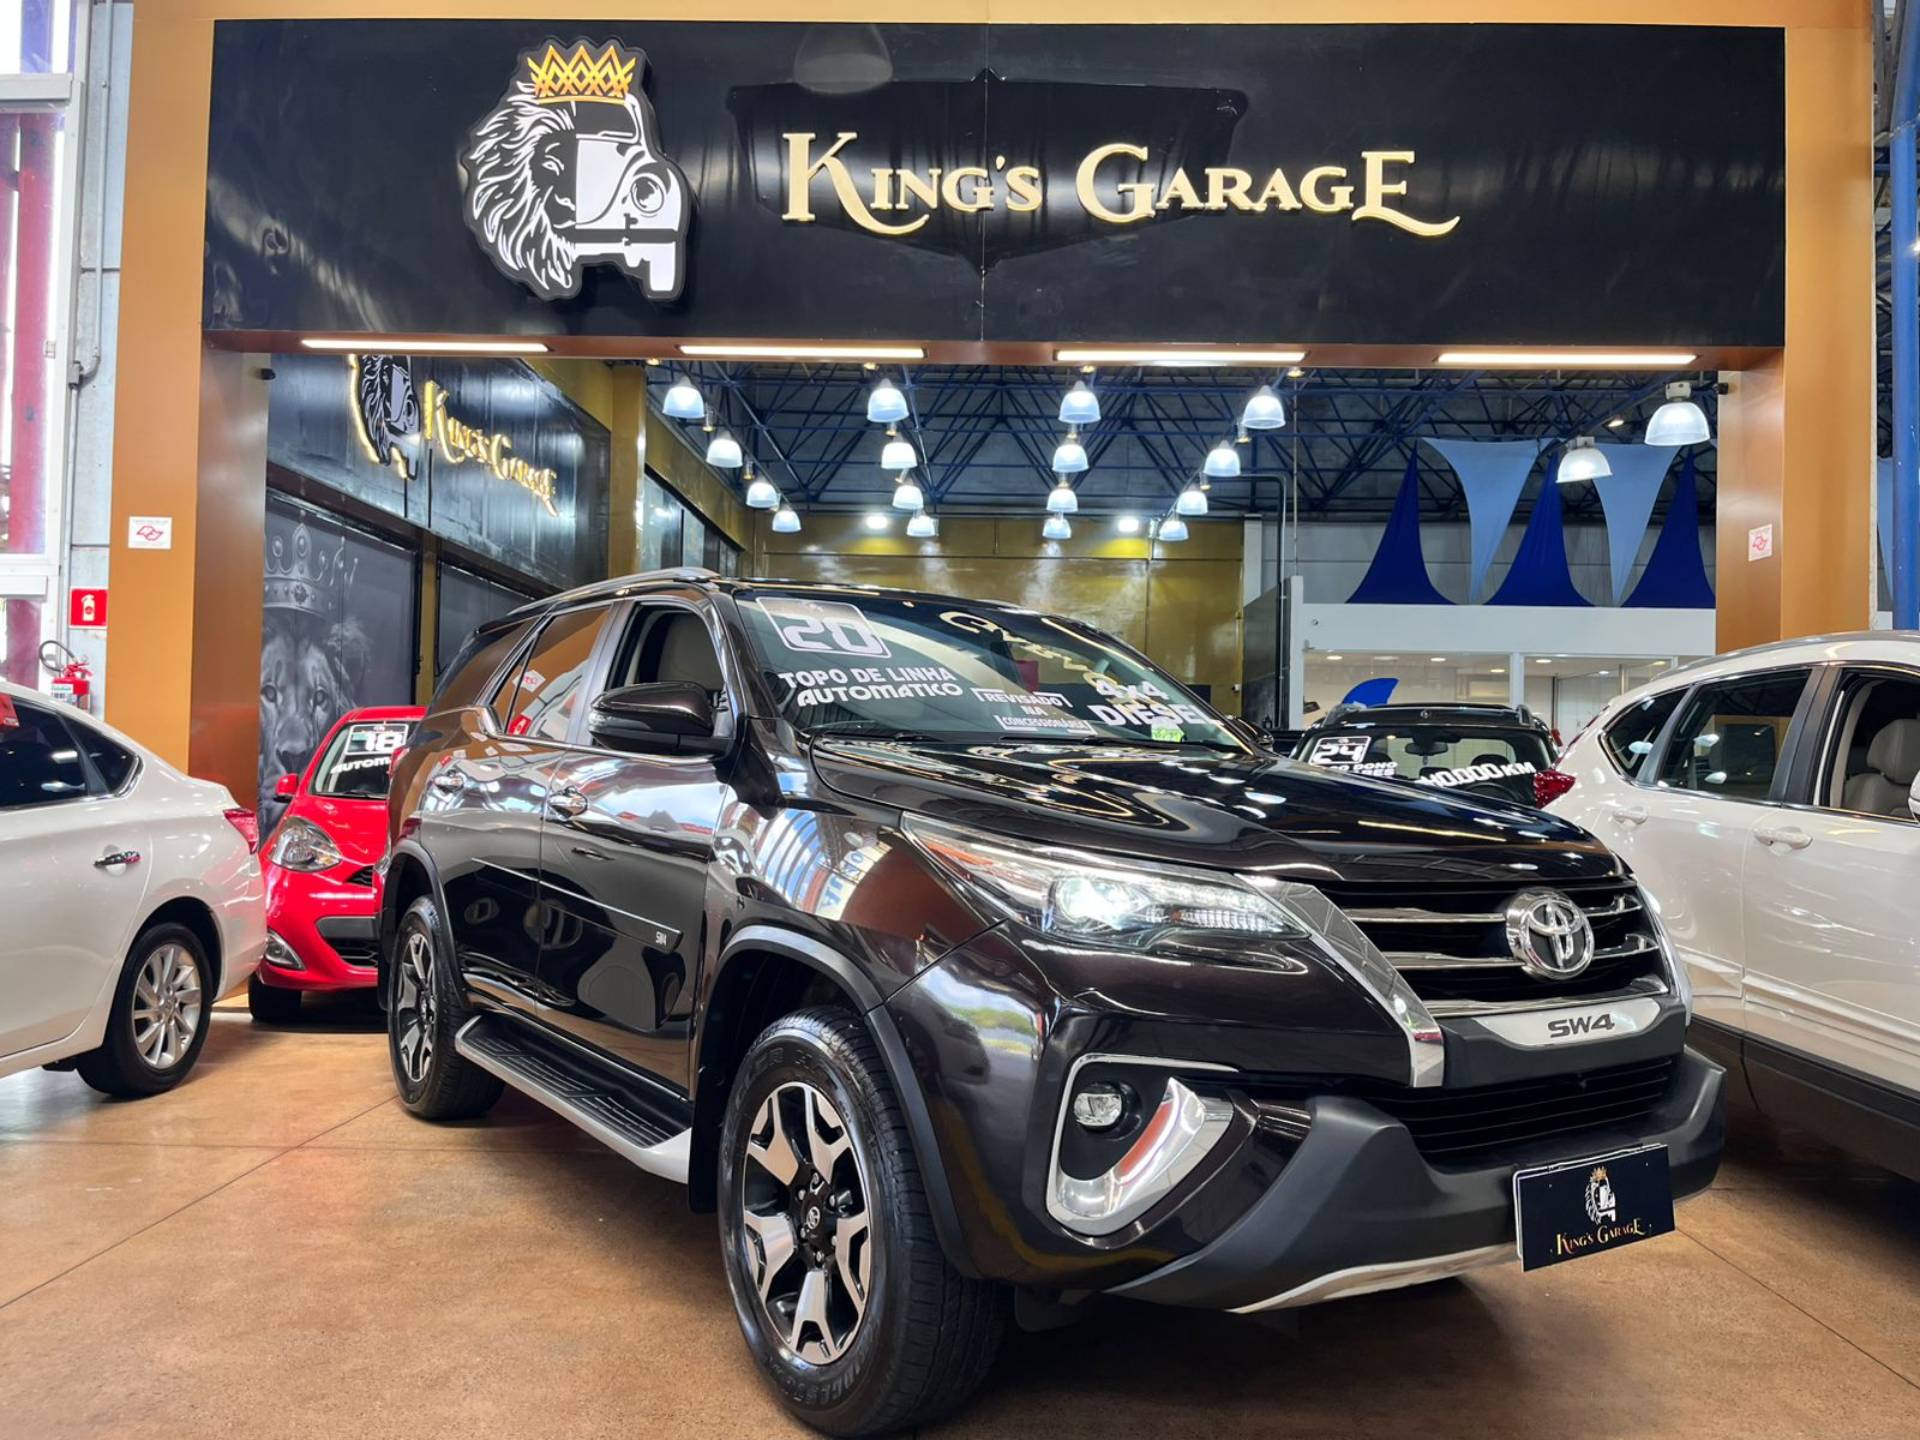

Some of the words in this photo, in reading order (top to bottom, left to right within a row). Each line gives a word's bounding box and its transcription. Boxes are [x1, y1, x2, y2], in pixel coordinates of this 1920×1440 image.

[782, 132, 1042, 235] KING'S
[1076, 143, 1460, 236] GARAGE
[783, 616, 883, 653] 20
[778, 668, 848, 688] TOPO
[851, 668, 886, 683] DE
[886, 667, 958, 683] LINHA
[985, 693, 1063, 706] REVISADO
[1020, 705, 1048, 716] NA
[1088, 704, 1225, 726] DIESEL
[1313, 743, 1363, 763] 24
[1547, 1013, 1616, 1038] SW4
